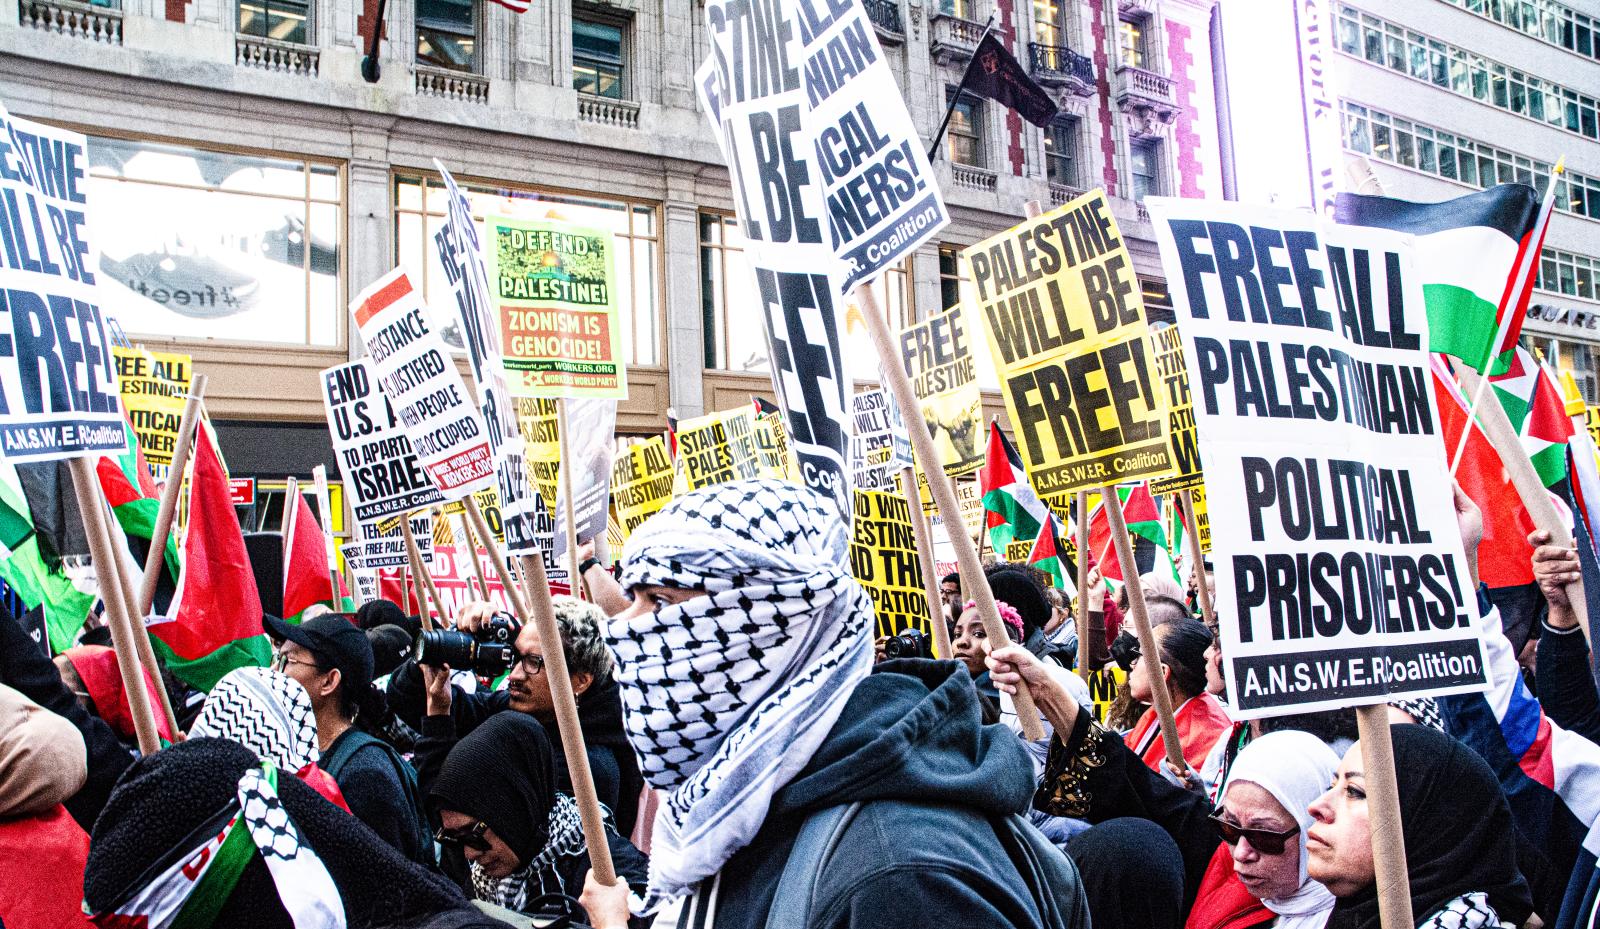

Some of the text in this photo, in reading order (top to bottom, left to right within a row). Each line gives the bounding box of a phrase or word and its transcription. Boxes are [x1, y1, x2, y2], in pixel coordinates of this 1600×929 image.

[748, 103, 823, 244] BE
[46, 203, 96, 286] BE
[510, 228, 589, 256] DEFEND
[866, 205, 937, 265] Coalition
[970, 196, 1123, 302] PALESTINE
[501, 276, 608, 304] PALESTINE!
[1166, 218, 1421, 352] FREE ALL
[508, 311, 600, 335] ZIONISM IS
[984, 253, 1140, 365] WILL BE
[511, 336, 602, 360] GENOCIDE!
[900, 308, 968, 378] FREE
[152, 360, 190, 384] ALL
[325, 363, 371, 407] END
[389, 348, 446, 398] JUSTIFIED
[544, 374, 617, 387] WORKERS WORLD PARTY
[554, 362, 614, 374] WORKERS.ORG
[333, 400, 382, 441] U.S.
[419, 384, 463, 421] PEOPLE
[1007, 336, 1162, 467] FREE!
[423, 415, 480, 456] OCCUPIED
[679, 422, 727, 455] STAND
[725, 413, 751, 440] WITH
[342, 447, 361, 469] TO
[613, 451, 643, 487] FREE
[643, 443, 672, 476] ALL
[687, 435, 756, 480] PALESTINE!
[1036, 450, 1167, 490] A.N.S.W.E.R. Coalition
[358, 498, 410, 518] A.N.S.W.E.R.
[1240, 456, 1433, 545] POLITICAL
[364, 542, 385, 556] FREE
[853, 518, 916, 552] ESTINE
[1383, 650, 1477, 683] Coalition
